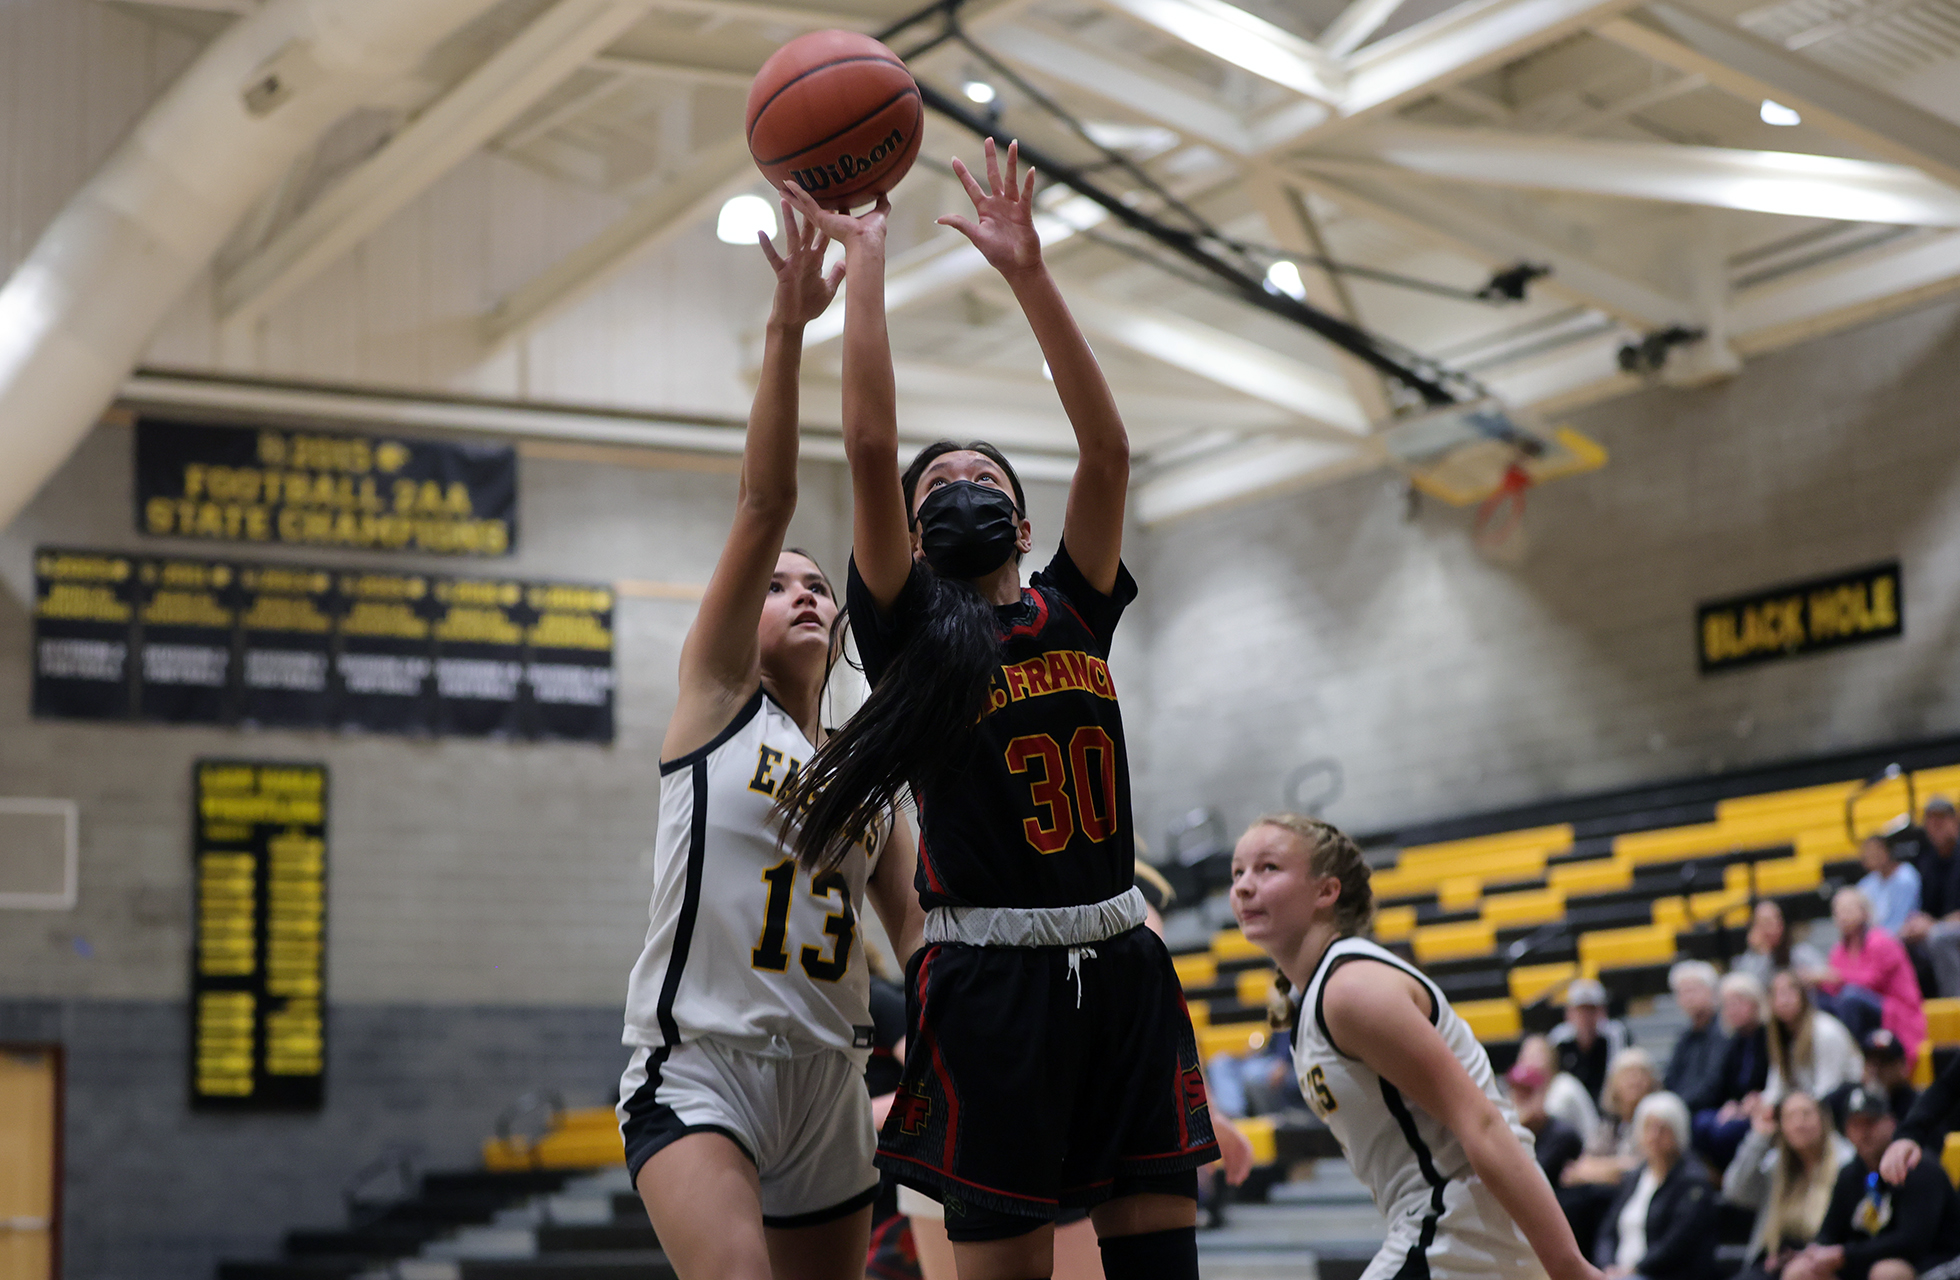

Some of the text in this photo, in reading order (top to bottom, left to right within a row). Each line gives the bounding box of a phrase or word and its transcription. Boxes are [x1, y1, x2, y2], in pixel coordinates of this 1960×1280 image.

[790, 128, 903, 192] Wilson
[184, 462, 383, 511] FOOTBALL
[147, 497, 508, 555] STATE CHAMPIONS
[1704, 575, 1897, 662] BLACK HOLE
[1004, 726, 1117, 855] 30
[751, 855, 857, 983] 13
